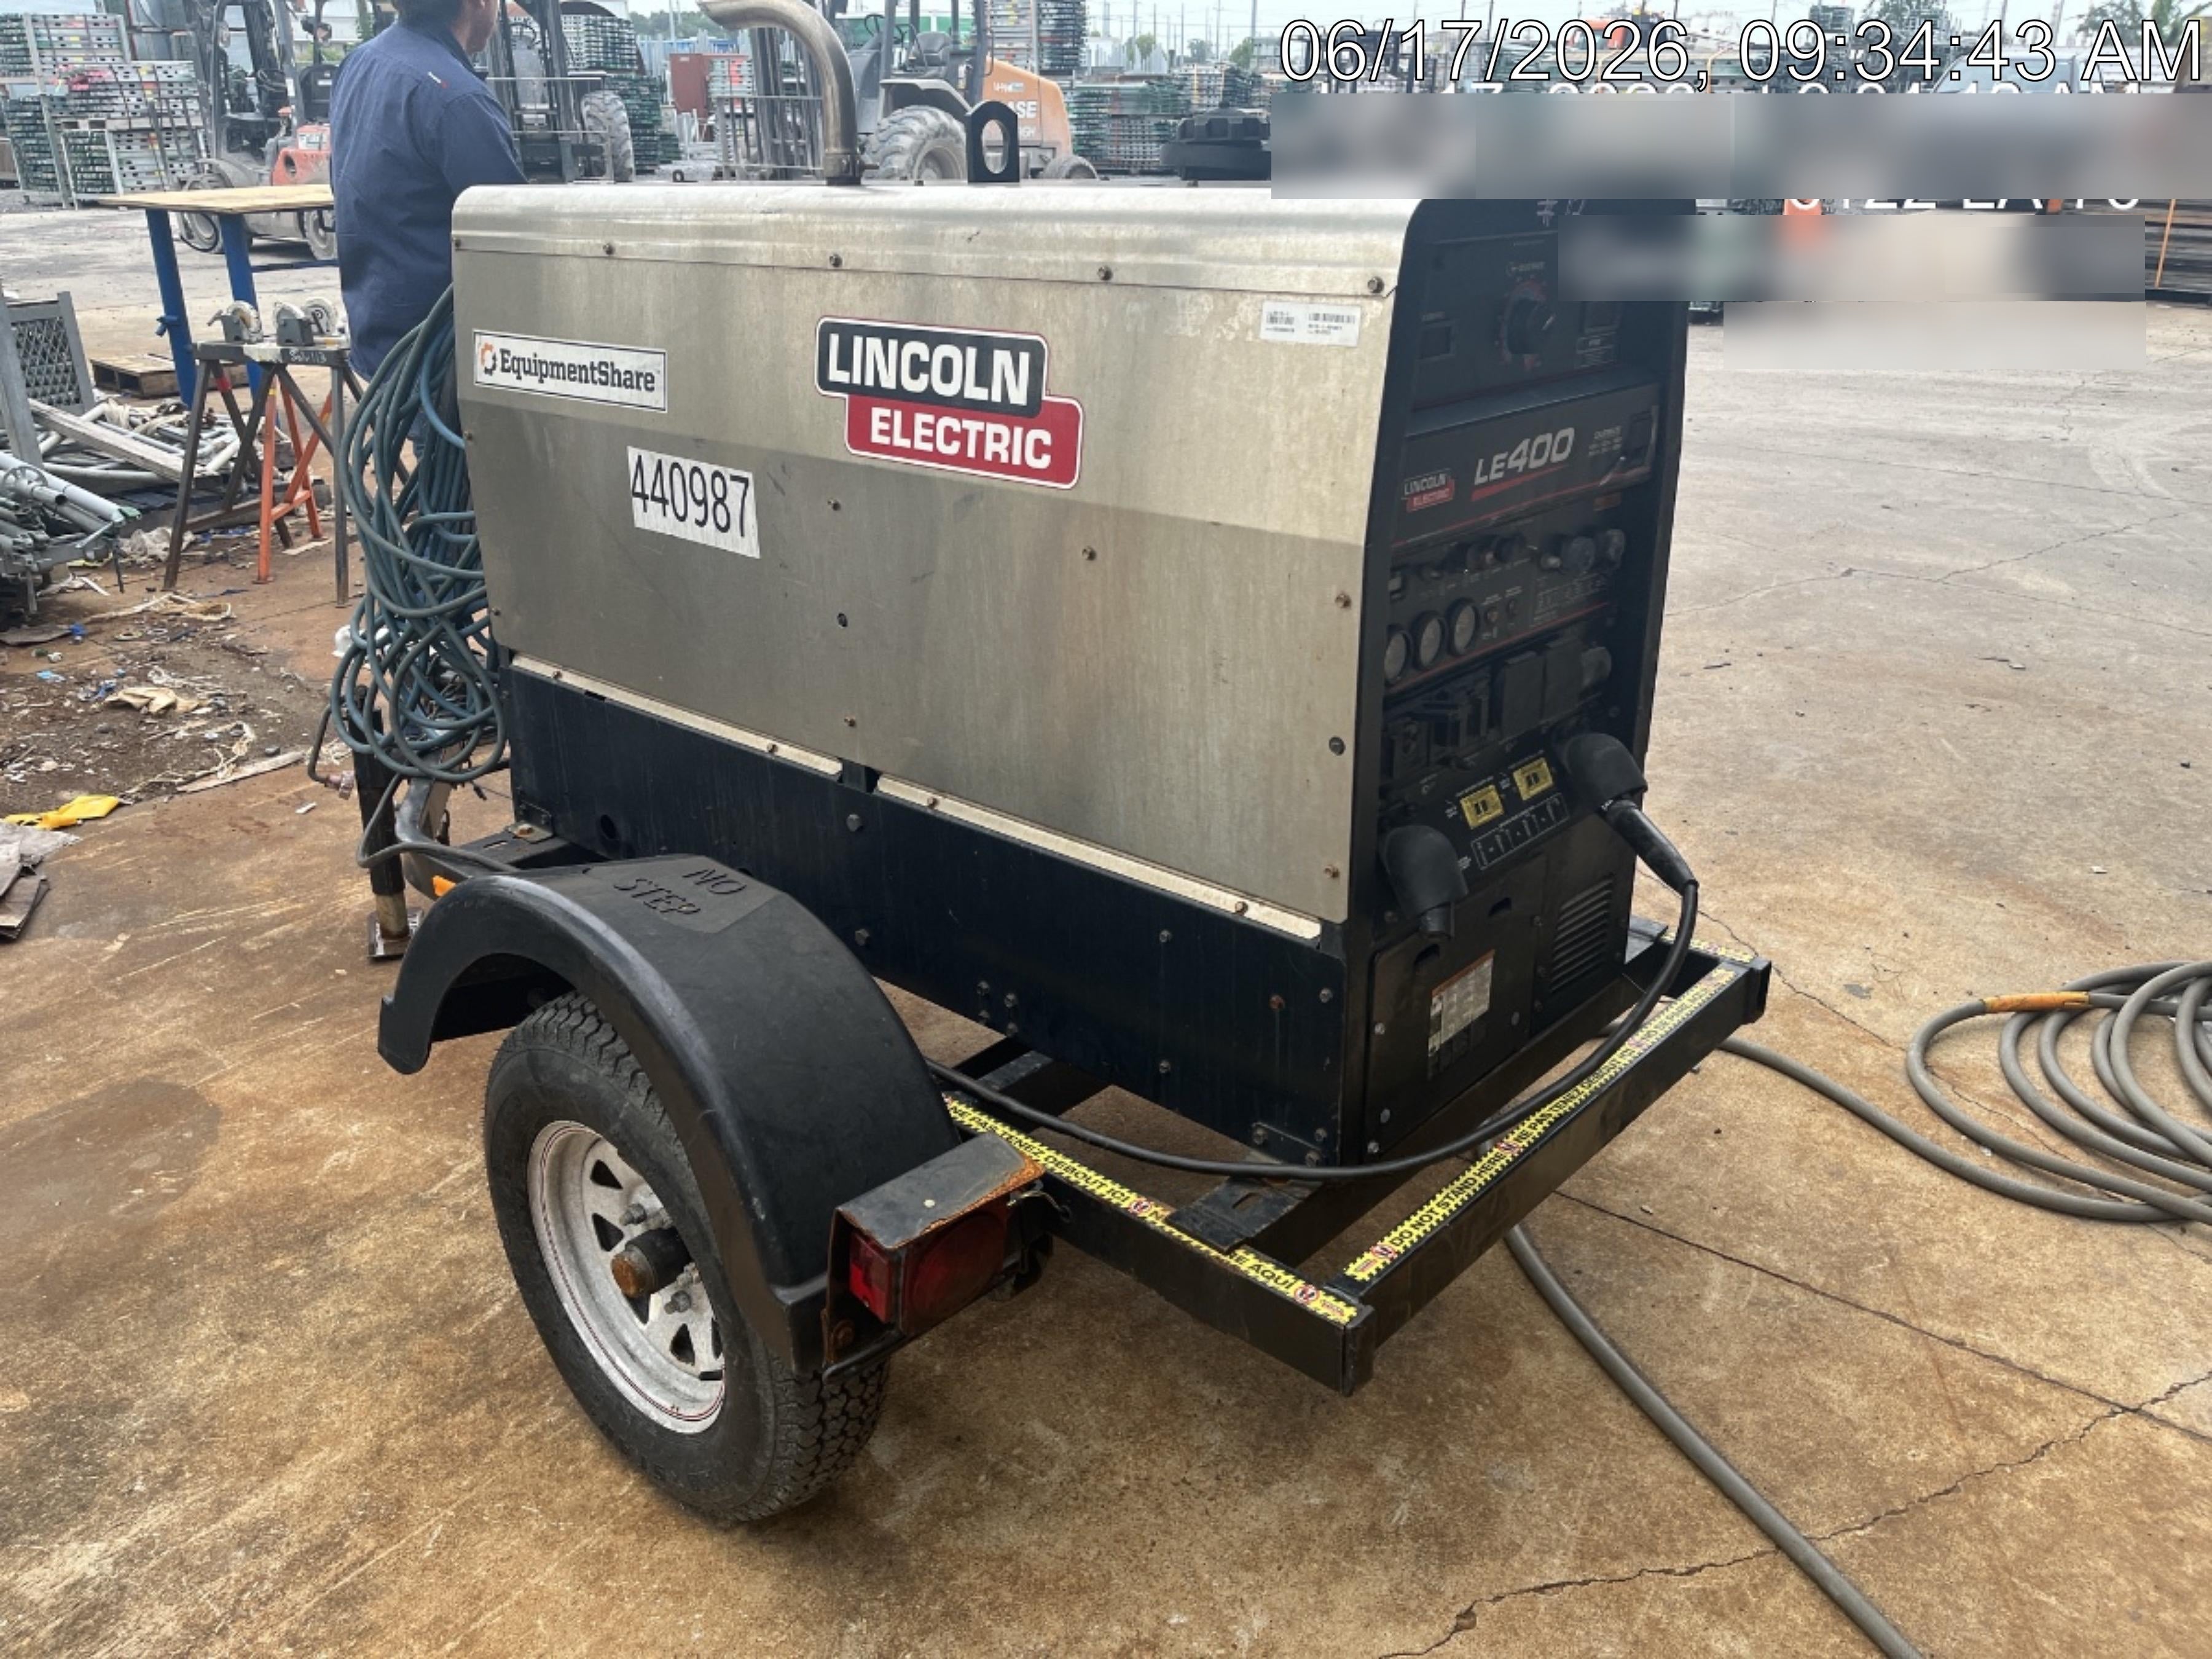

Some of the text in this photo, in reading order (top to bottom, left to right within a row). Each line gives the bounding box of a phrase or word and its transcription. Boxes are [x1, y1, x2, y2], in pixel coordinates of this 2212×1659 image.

[499, 348, 656, 392] EquipmentShare
[828, 333, 1030, 407] LINCOLN
[871, 406, 1053, 469] ELECTRIC
[1474, 427, 1575, 485] LE400
[632, 454, 750, 538] 440987
[1404, 473, 1446, 496] LINCOLN
[1045, 1155, 1107, 1190] DEBOUT
[1389, 1151, 1504, 1247] DO NOT STAND HERE
